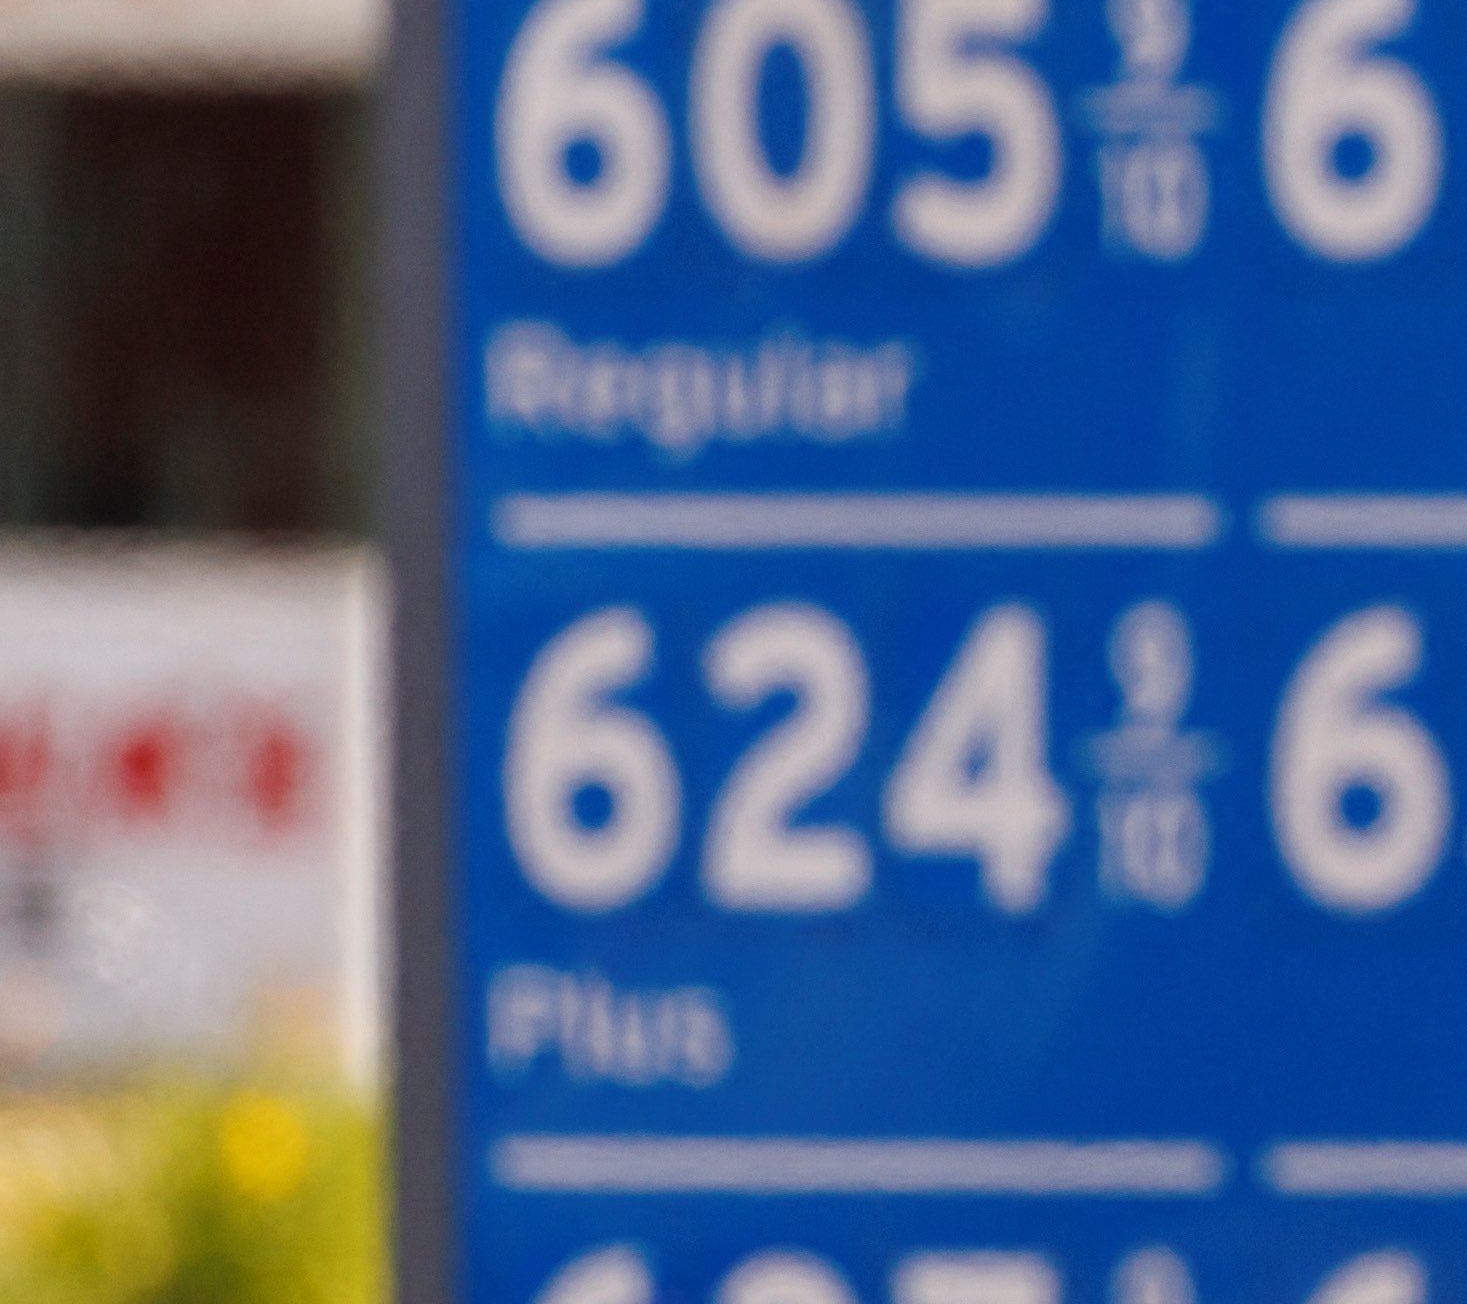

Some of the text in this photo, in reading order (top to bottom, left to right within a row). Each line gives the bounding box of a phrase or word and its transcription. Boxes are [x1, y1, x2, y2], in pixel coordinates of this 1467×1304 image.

[486, 324, 910, 452] Regular
[505, 604, 1067, 910] 624
[489, 967, 731, 1084] Plus
